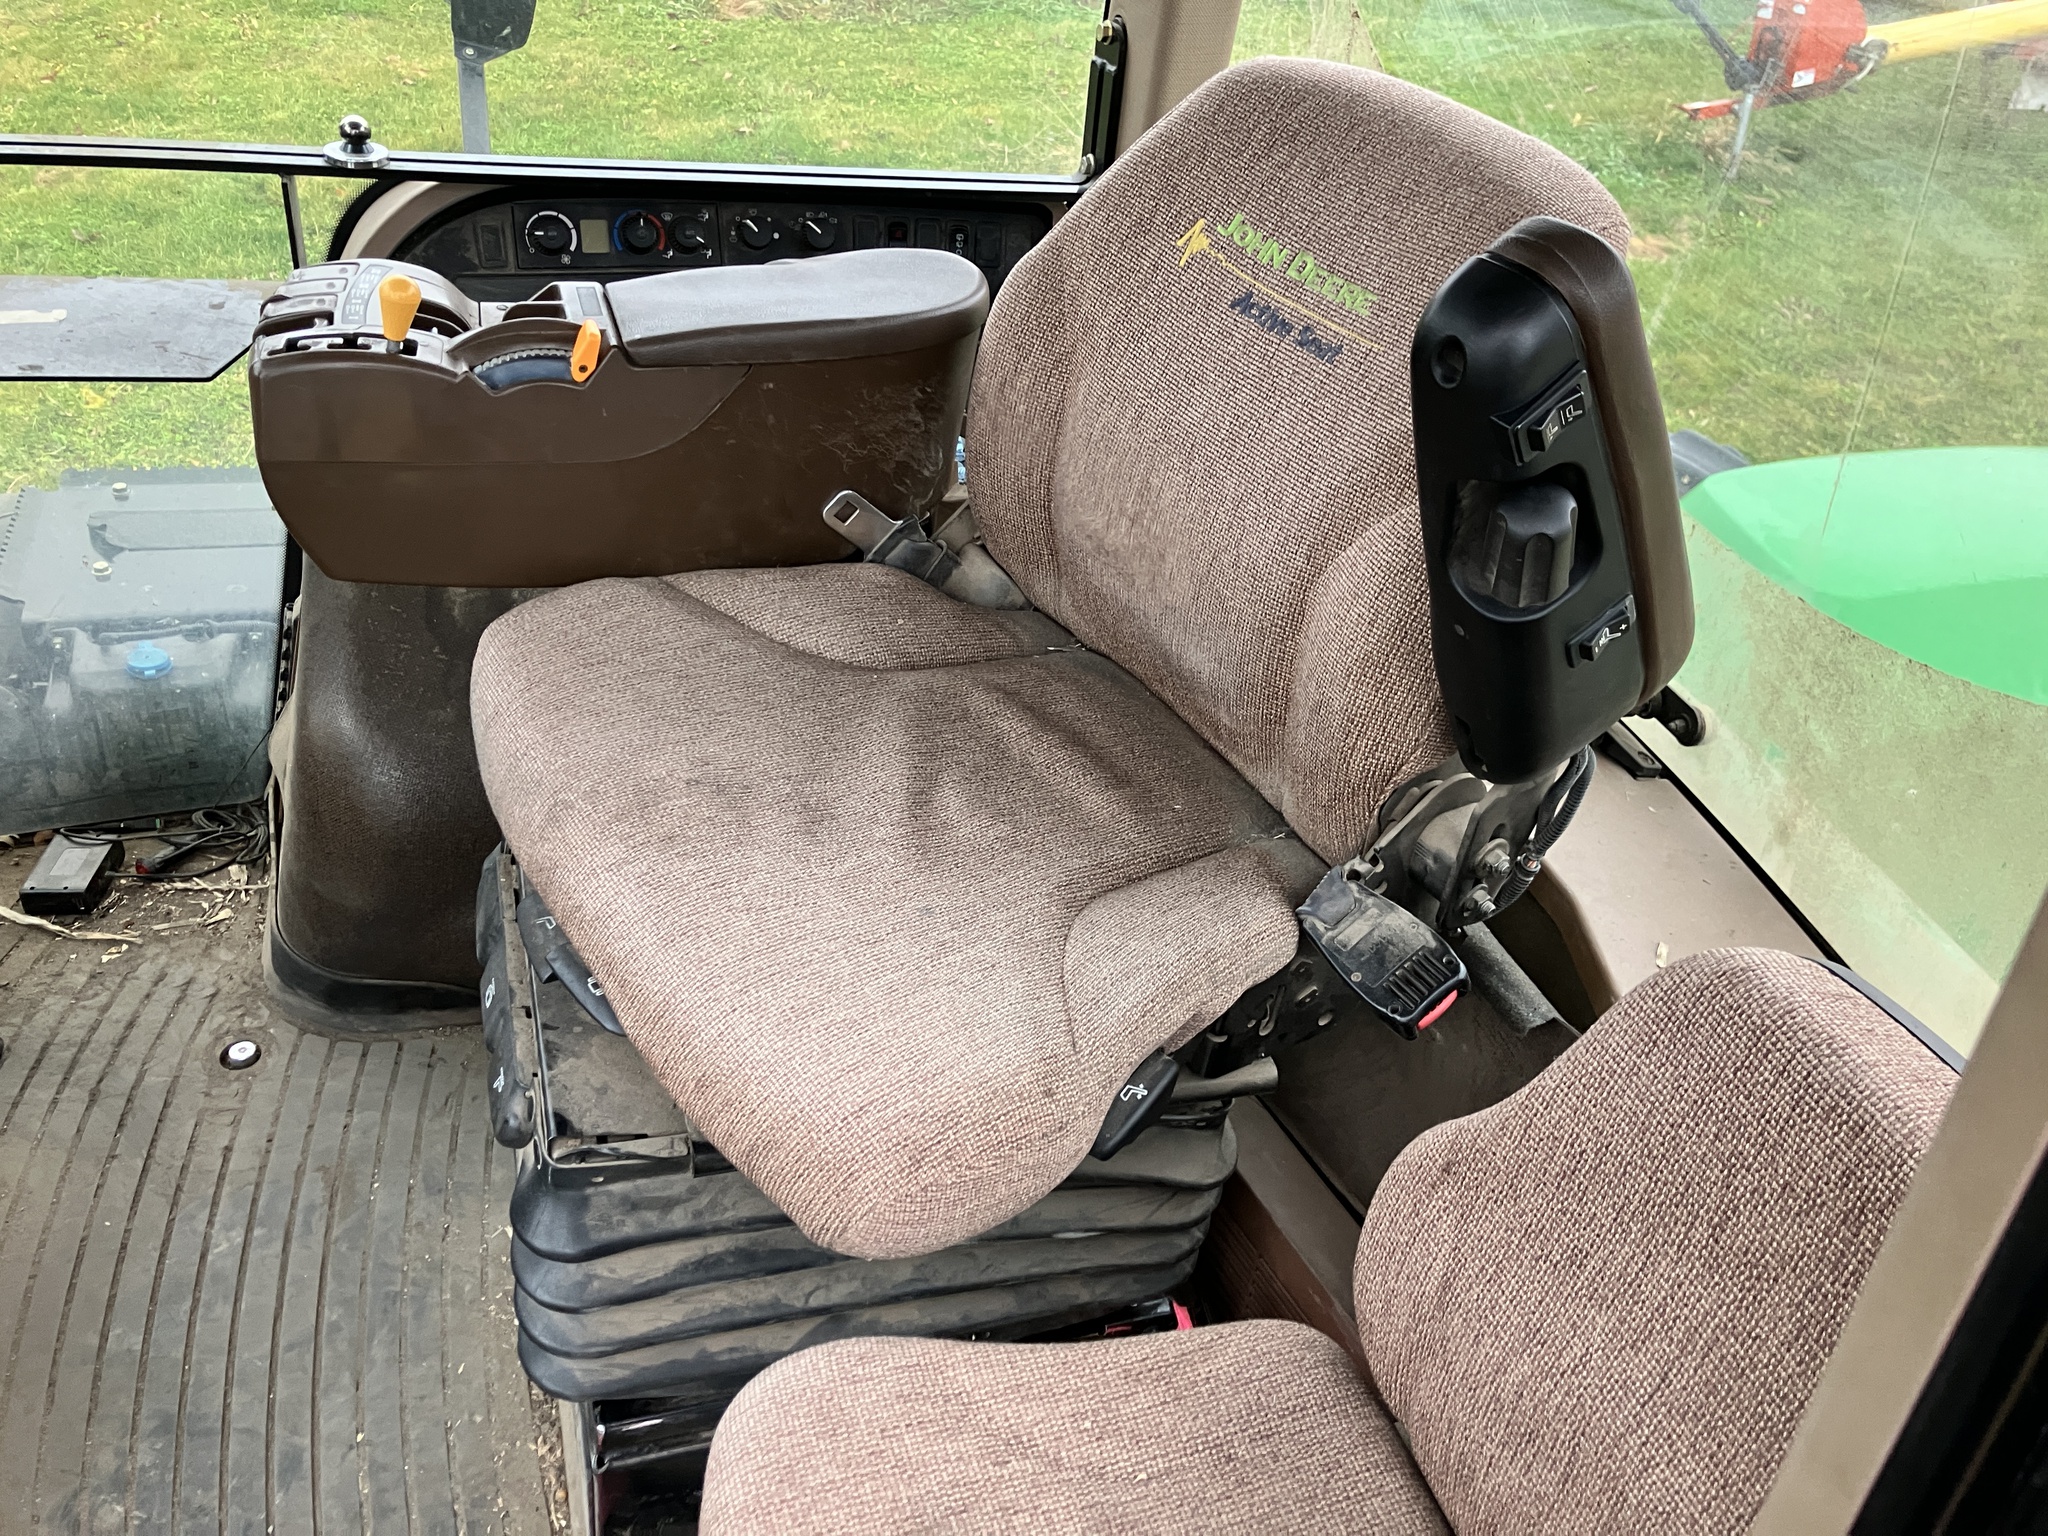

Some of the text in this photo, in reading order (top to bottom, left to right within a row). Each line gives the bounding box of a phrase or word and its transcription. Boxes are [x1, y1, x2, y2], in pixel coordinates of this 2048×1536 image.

[1217, 213, 1378, 317] JOHN DEERE
[1229, 291, 1344, 366] Active Seat
